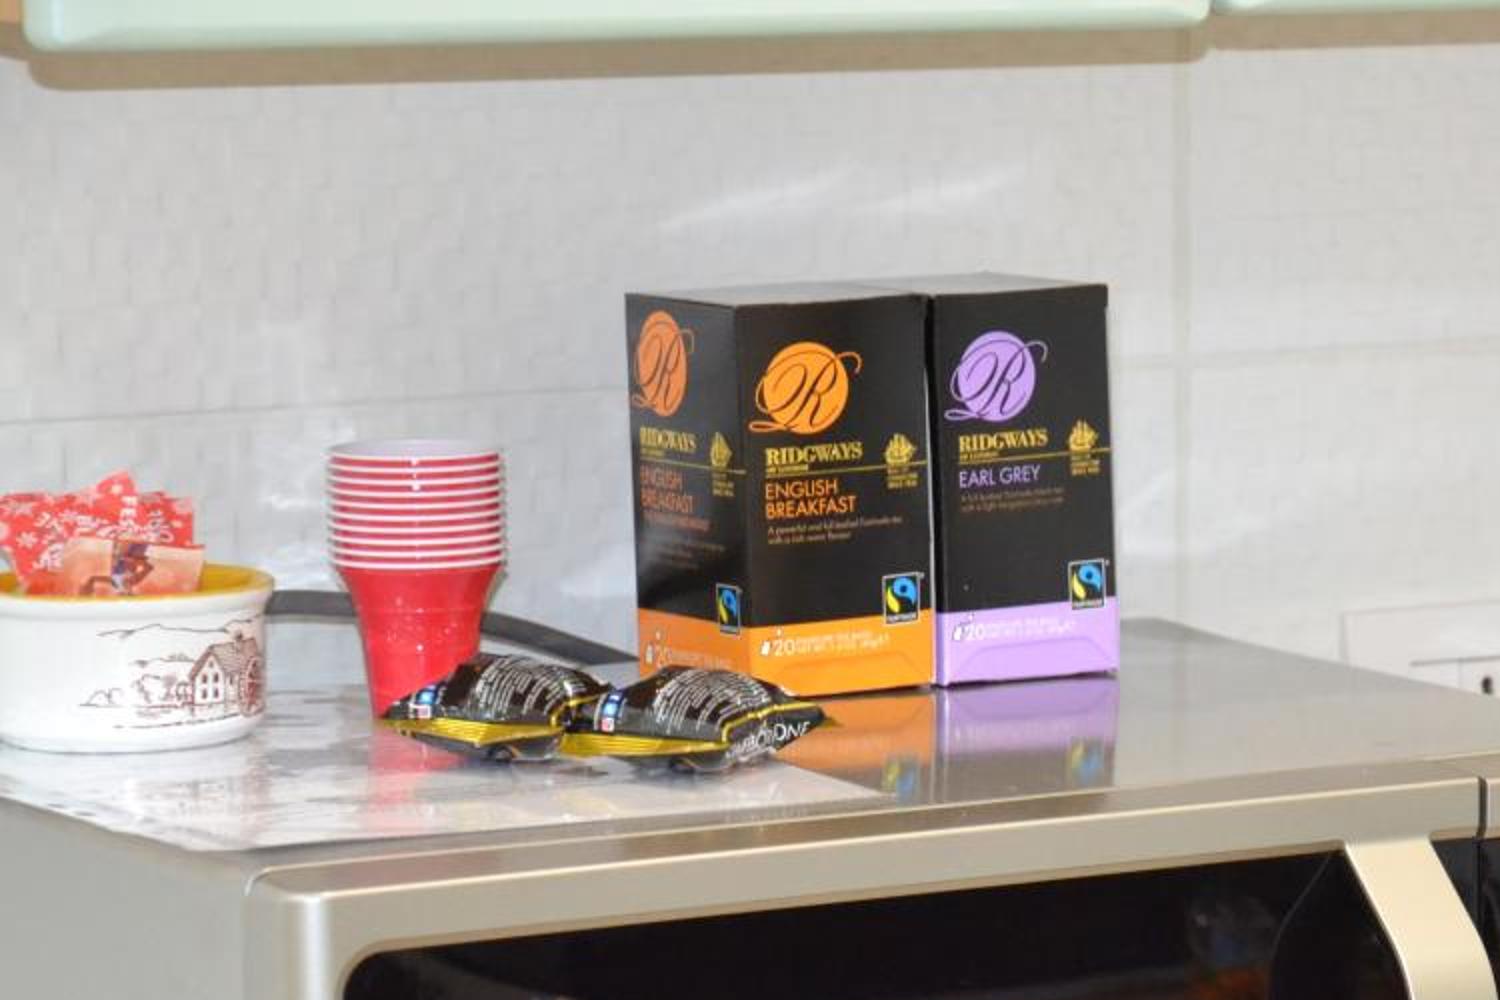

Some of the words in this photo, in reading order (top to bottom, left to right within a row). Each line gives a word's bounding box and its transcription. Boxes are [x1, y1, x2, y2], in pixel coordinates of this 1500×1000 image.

[959, 428, 1049, 451] RIDGWAYS
[765, 441, 864, 465] RIDGWAYS
[959, 469, 996, 488] EARL
[999, 464, 1041, 485] GREY
[765, 479, 839, 500] ENGLISH
[766, 495, 857, 519] BREAKFAST
[773, 638, 796, 657] 20
